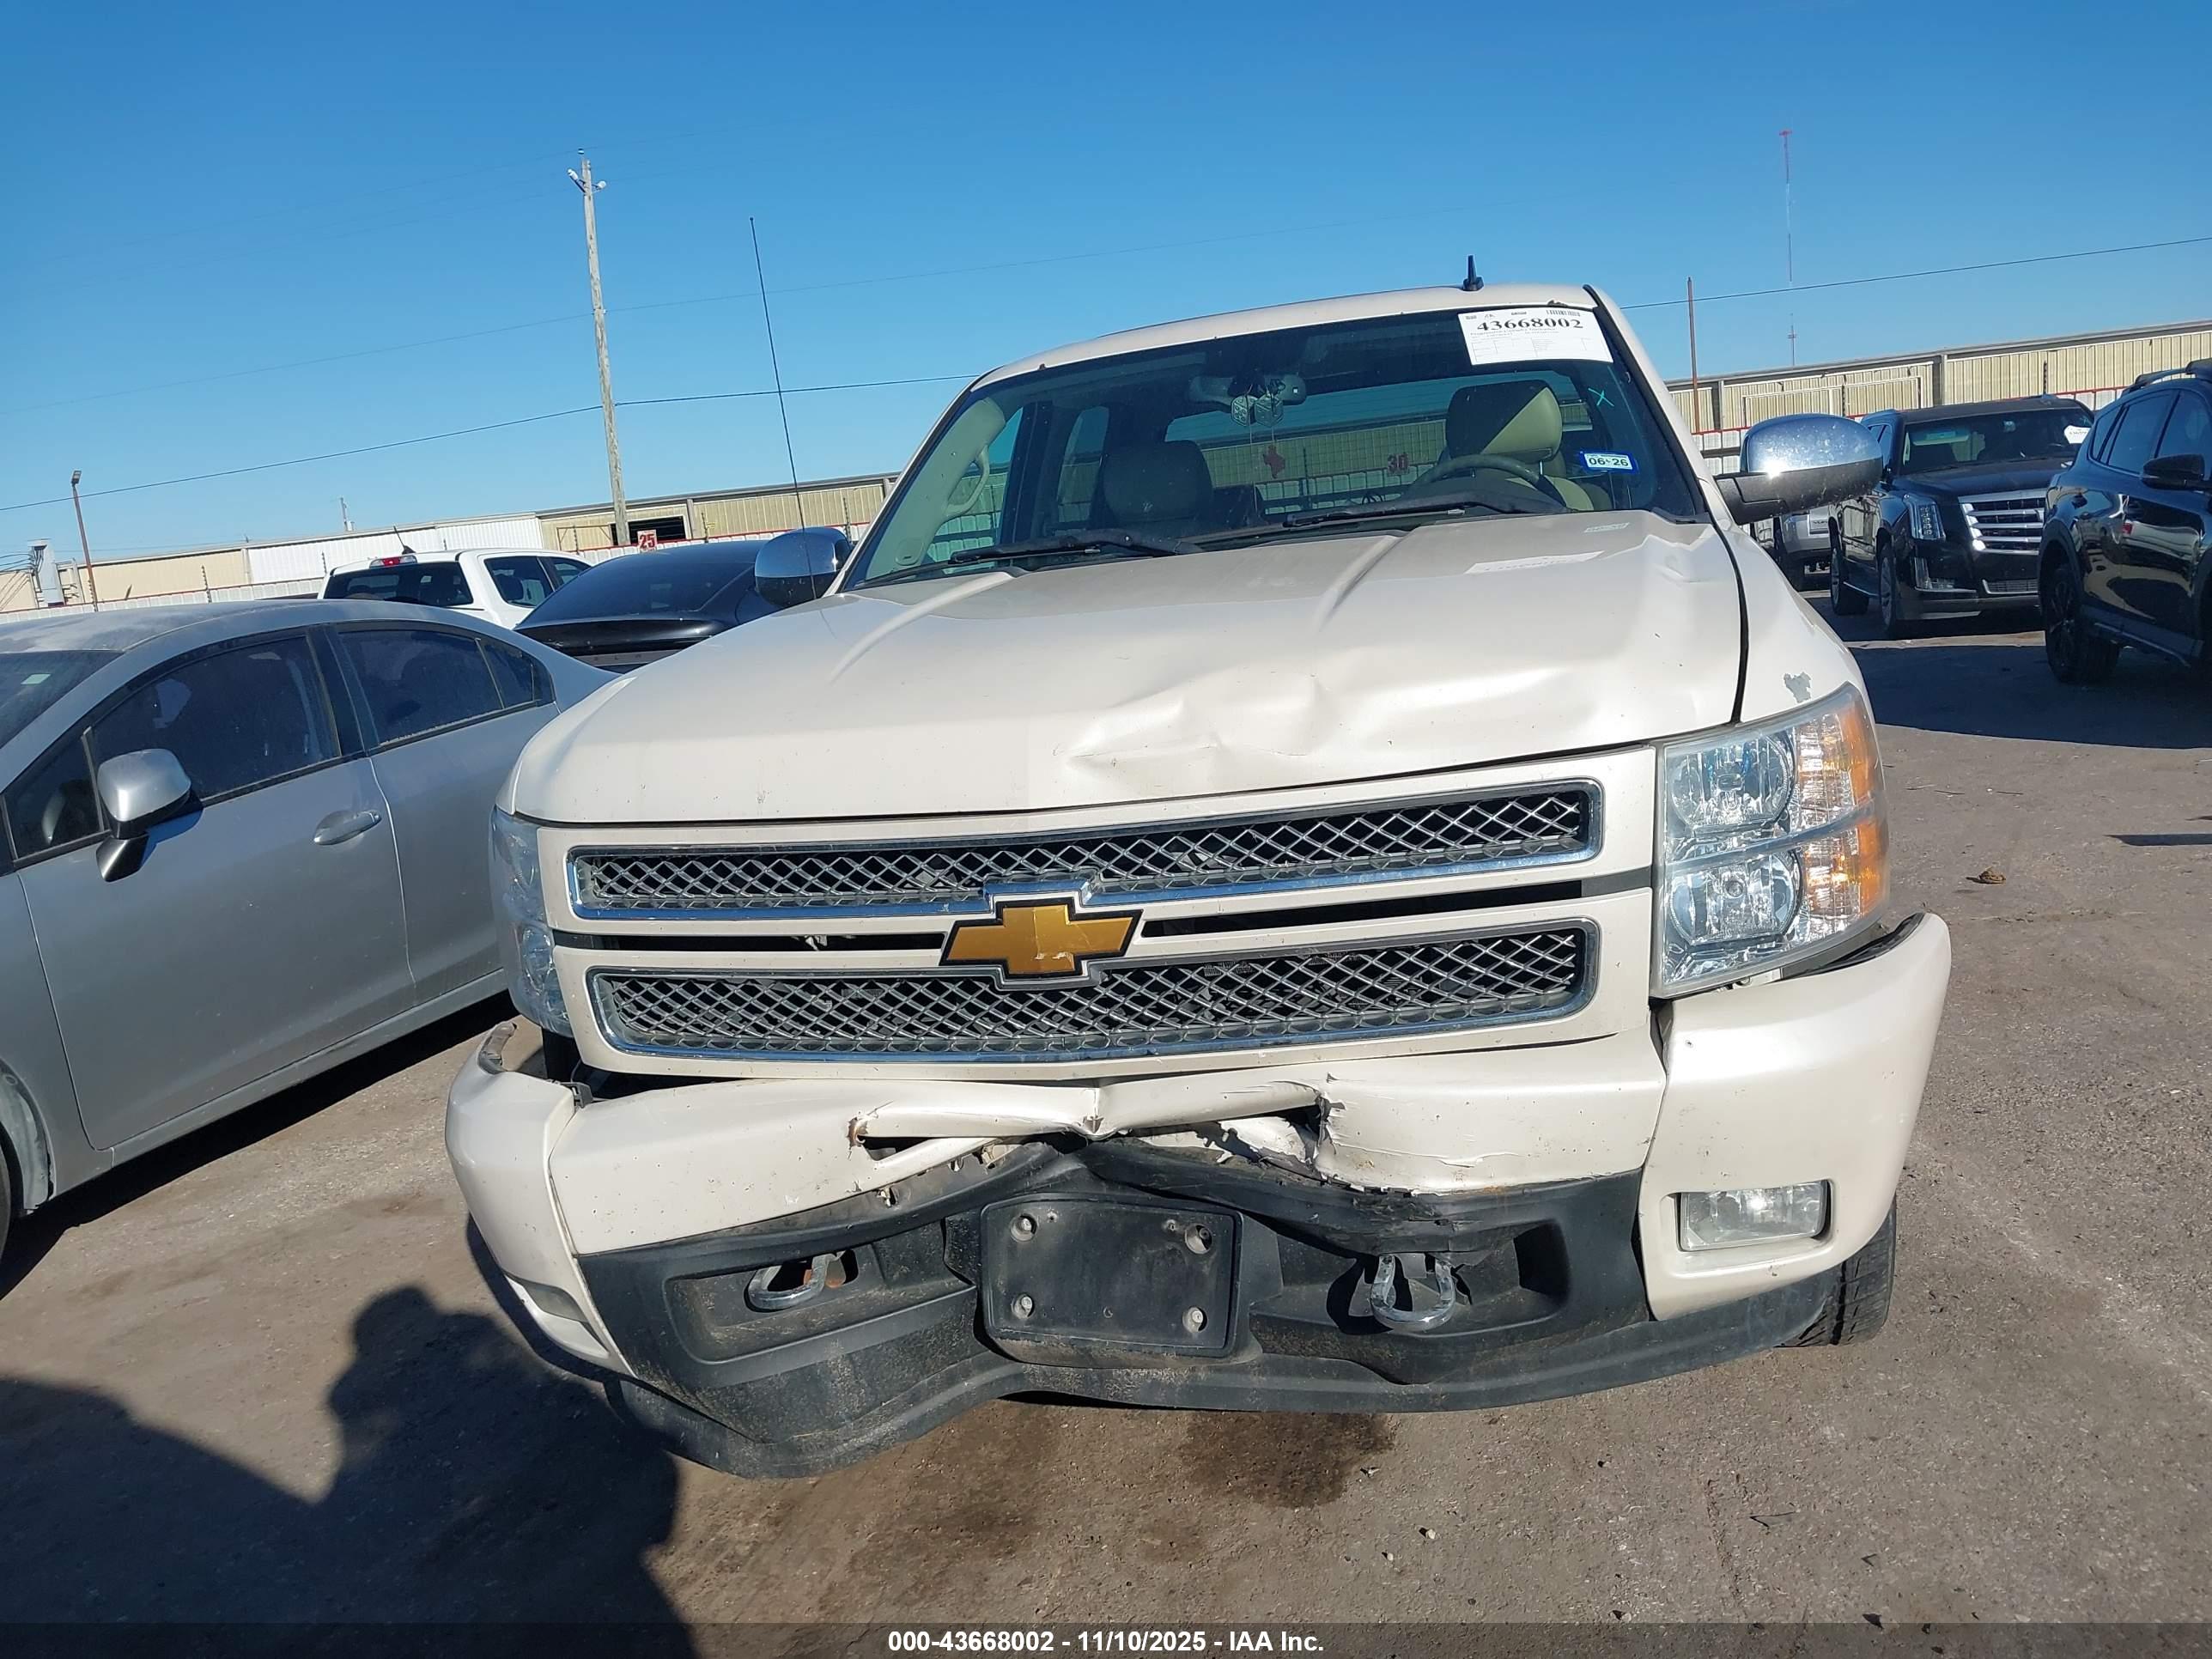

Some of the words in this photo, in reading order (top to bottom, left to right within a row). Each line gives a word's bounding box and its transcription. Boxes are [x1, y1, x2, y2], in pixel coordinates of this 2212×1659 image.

[1477, 318, 1583, 331] 43668002
[1589, 457, 1606, 465] 06
[1611, 458, 1629, 467] 26
[639, 533, 655, 550] 25
